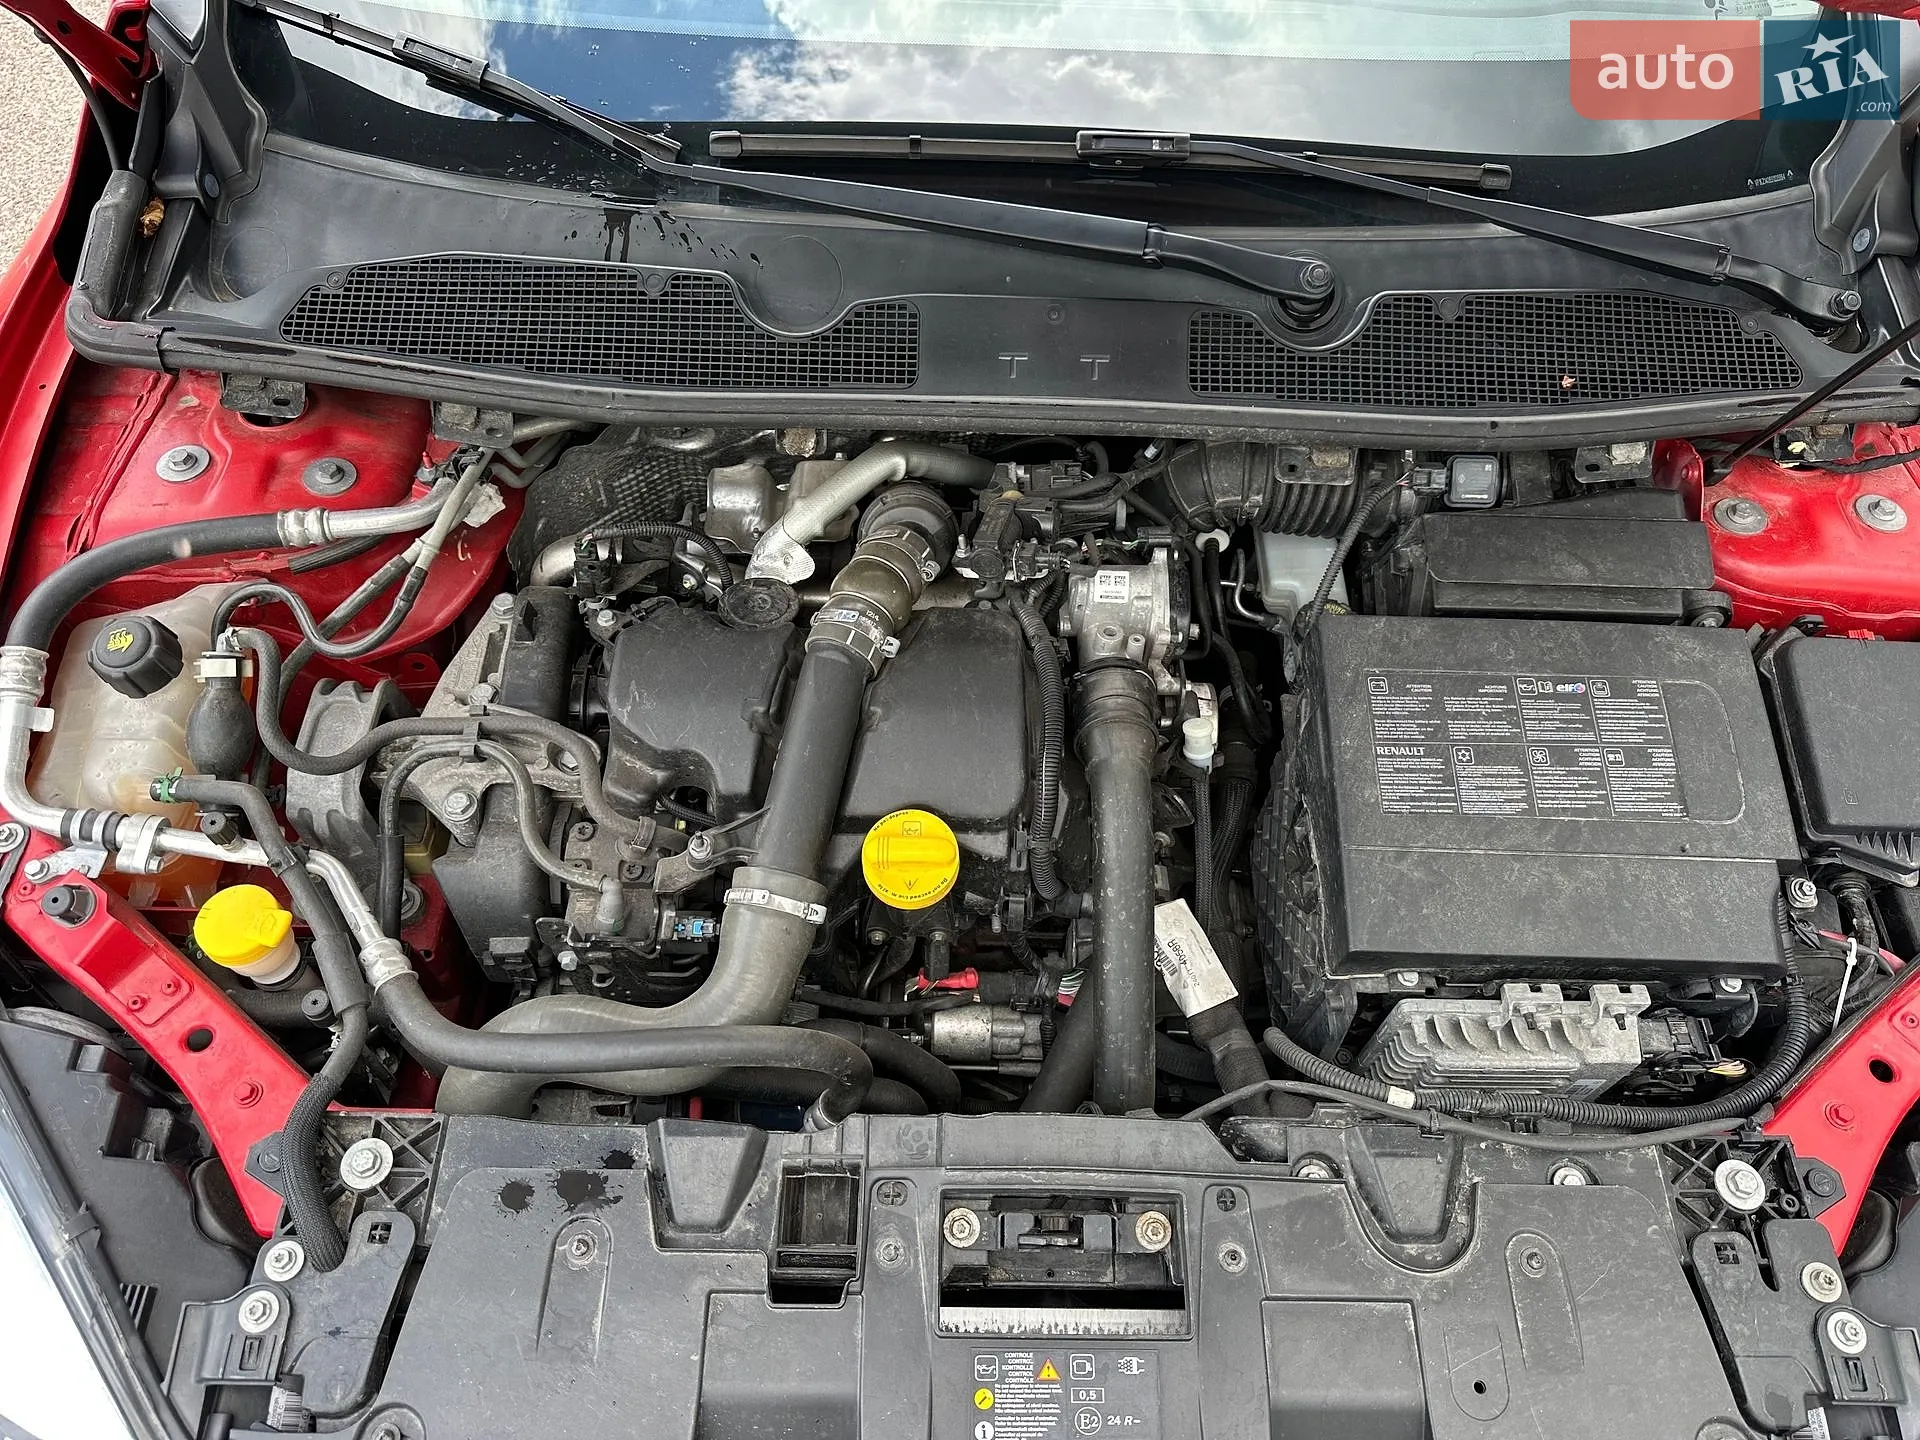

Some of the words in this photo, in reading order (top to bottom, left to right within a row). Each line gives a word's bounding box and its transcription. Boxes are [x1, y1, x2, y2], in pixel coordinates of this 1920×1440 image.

[1376, 746, 1425, 756] RENAULT
[1079, 1390, 1097, 1402] 0,5
[1079, 1413, 1099, 1430] E2
[1107, 1415, 1122, 1426] 24
